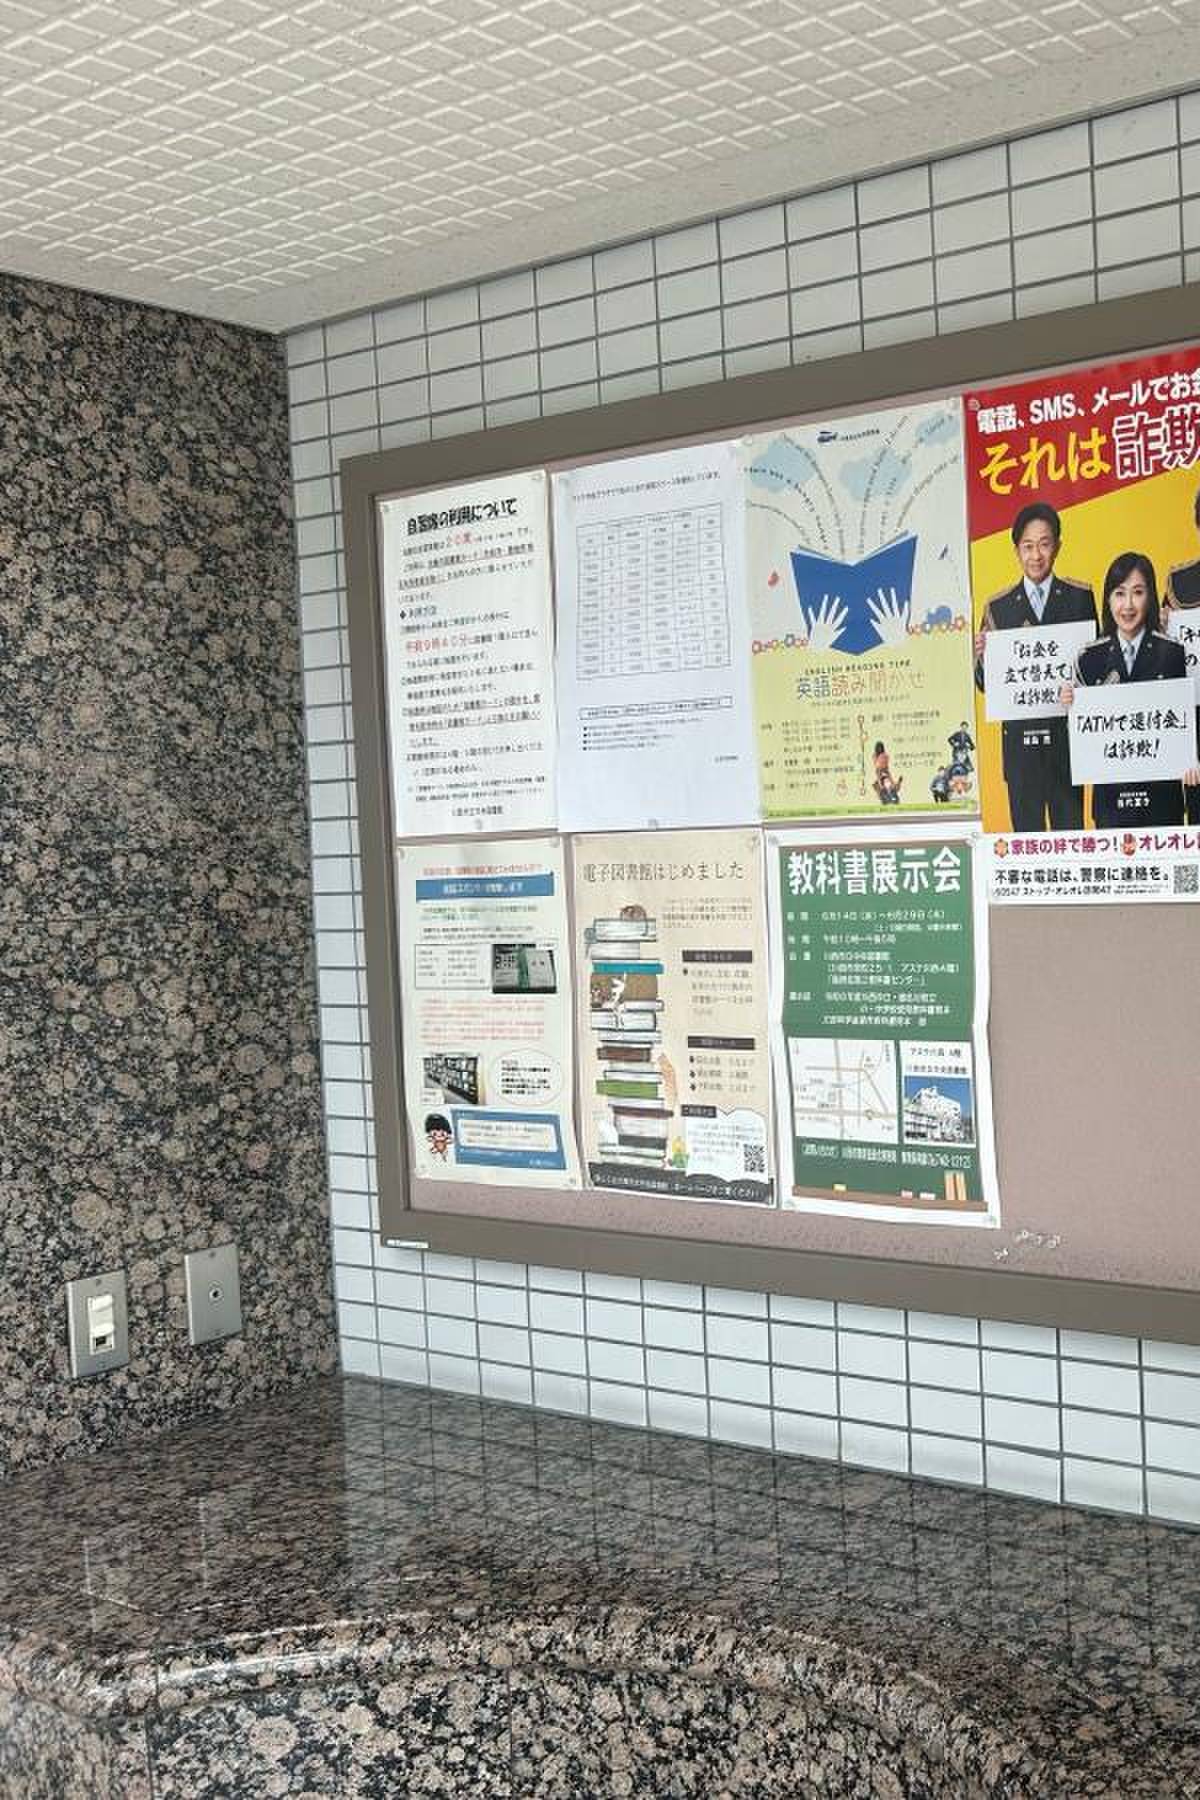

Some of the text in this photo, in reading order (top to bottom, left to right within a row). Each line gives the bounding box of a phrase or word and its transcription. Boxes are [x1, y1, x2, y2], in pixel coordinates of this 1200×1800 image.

[797, 670, 925, 700] 英語読み聞かせ
[583, 859, 745, 883] 電子図書館はじめました
[788, 846, 961, 895] 教科書展示会
[994, 865, 1169, 886] 不審な電話は、警察に連絡を。
